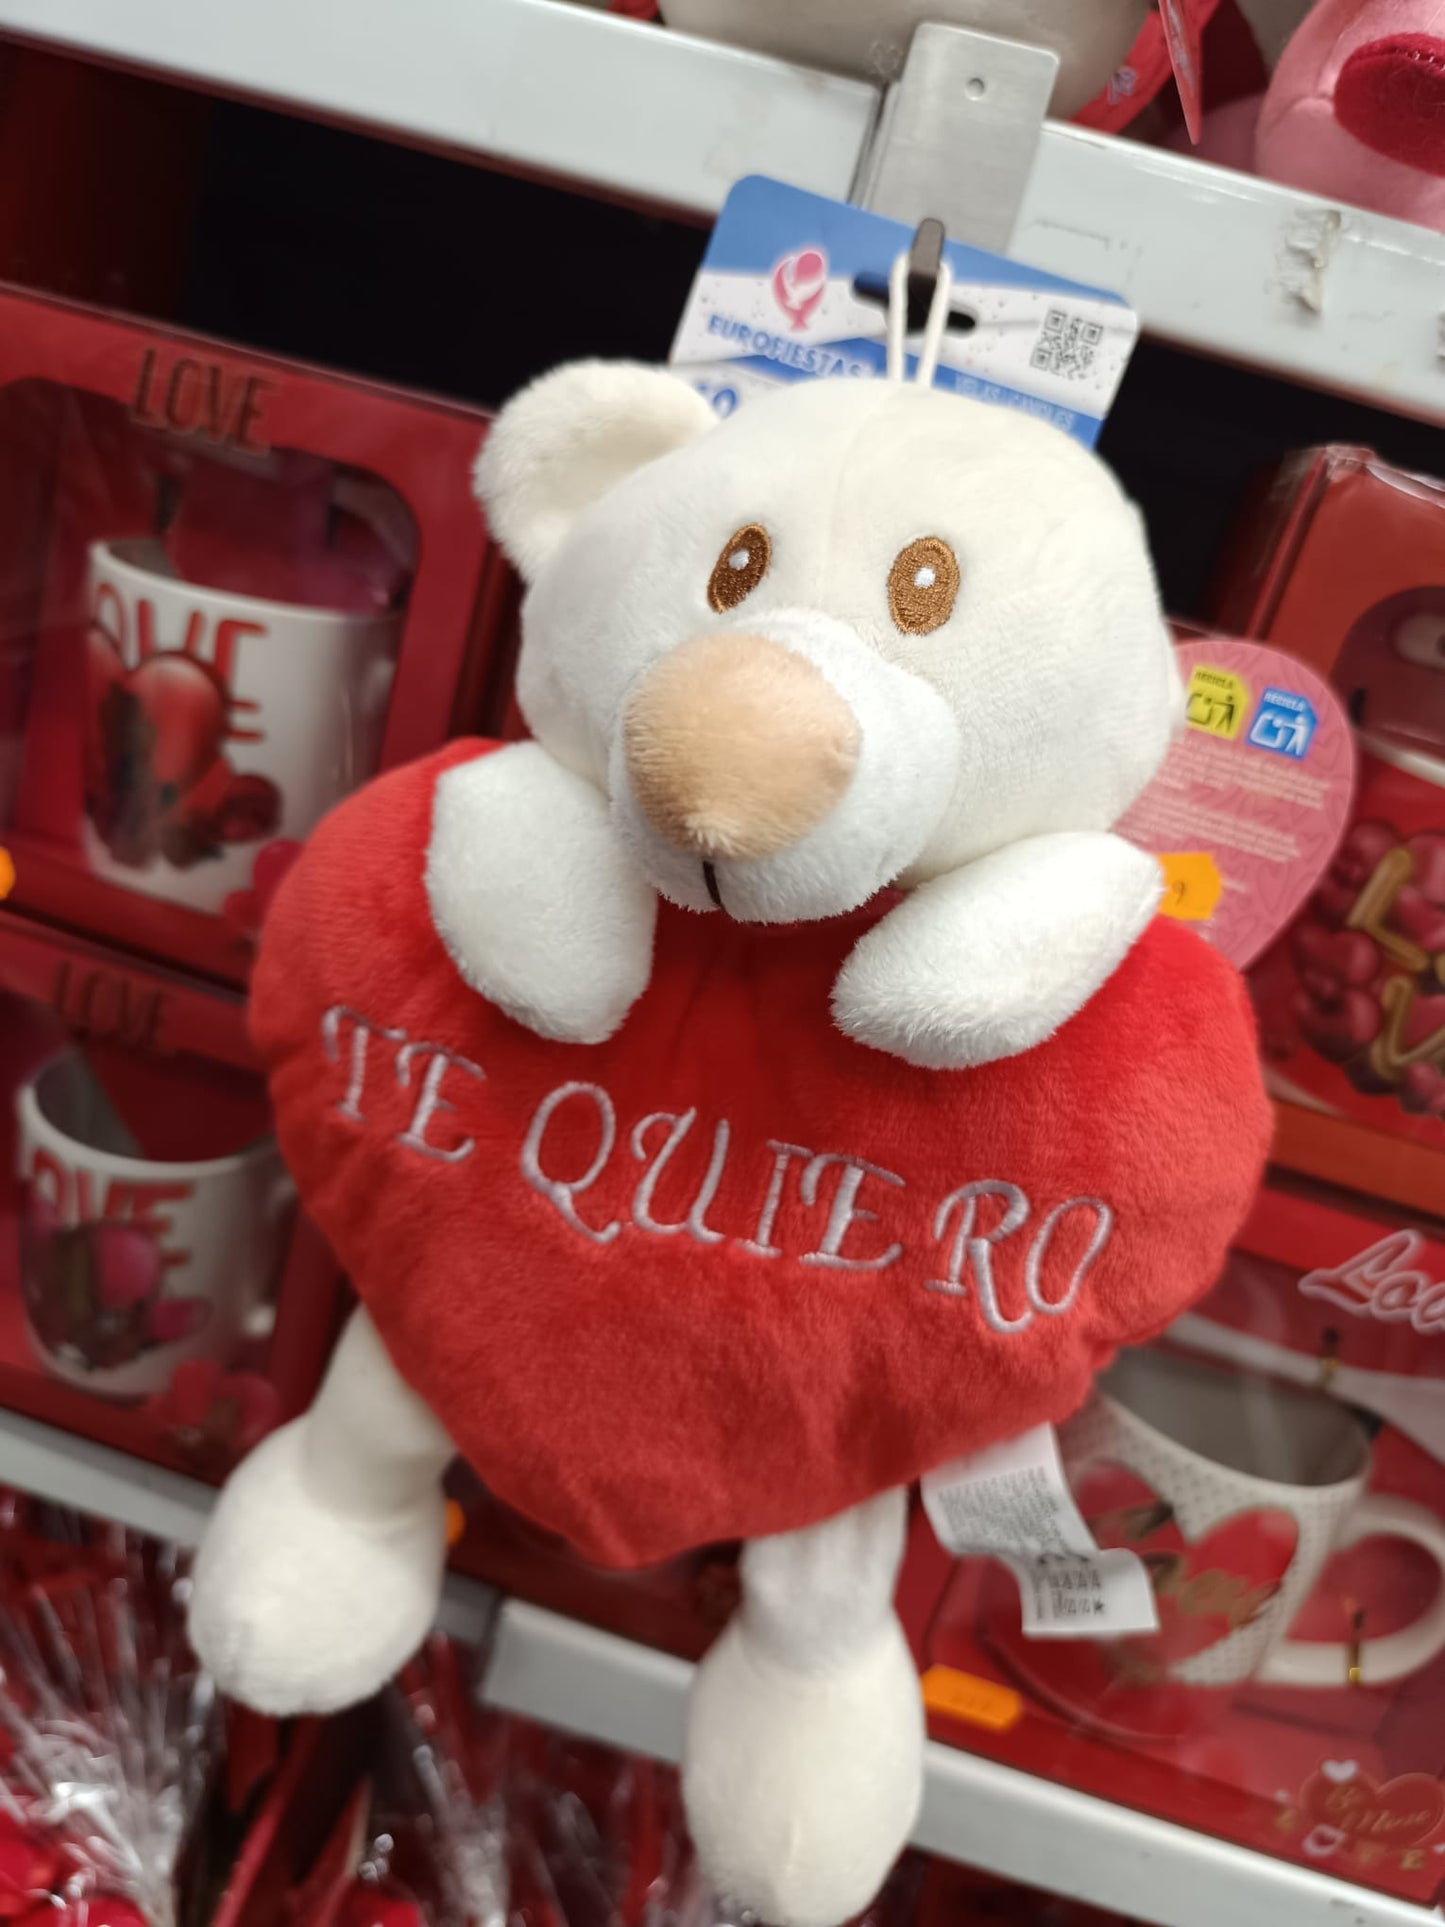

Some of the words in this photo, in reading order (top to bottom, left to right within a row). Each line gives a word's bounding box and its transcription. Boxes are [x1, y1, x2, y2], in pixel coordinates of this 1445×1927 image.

[134, 347, 279, 455] LOVE
[321, 1004, 487, 1163] TE
[519, 1079, 1114, 1334] QUIERO
